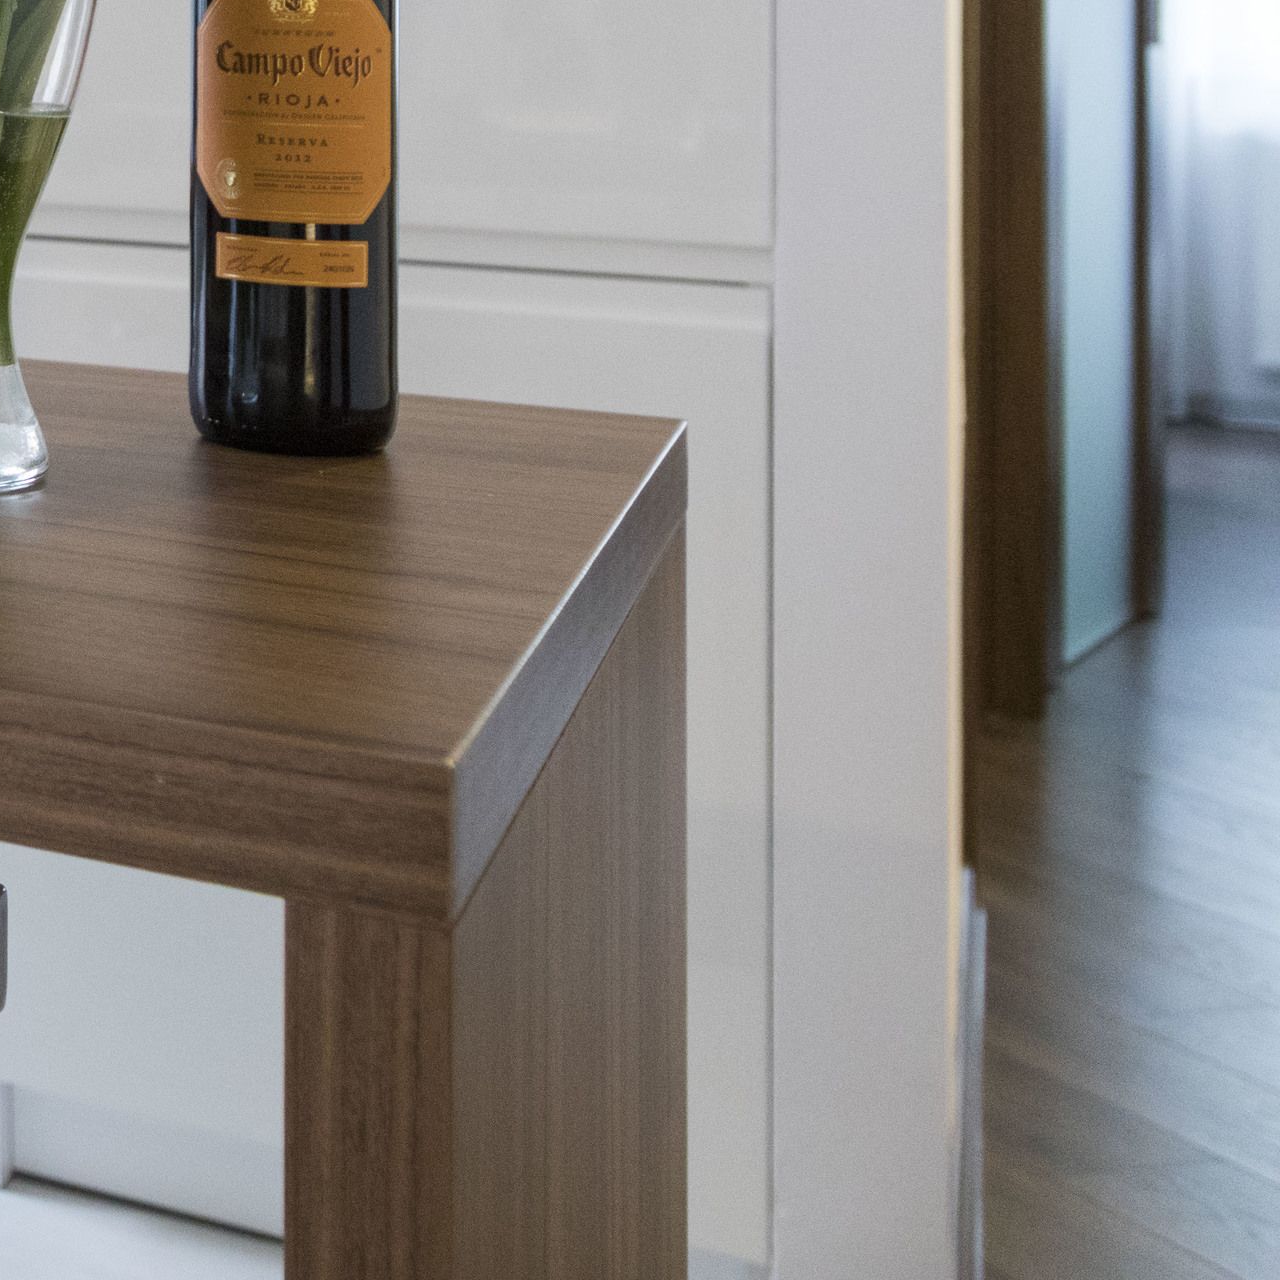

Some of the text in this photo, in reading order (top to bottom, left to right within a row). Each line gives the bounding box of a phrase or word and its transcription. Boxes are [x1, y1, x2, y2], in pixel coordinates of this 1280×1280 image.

[216, 40, 372, 89] Campo Viejo
[258, 92, 329, 108] RIOJA
[274, 153, 312, 163] 2012
